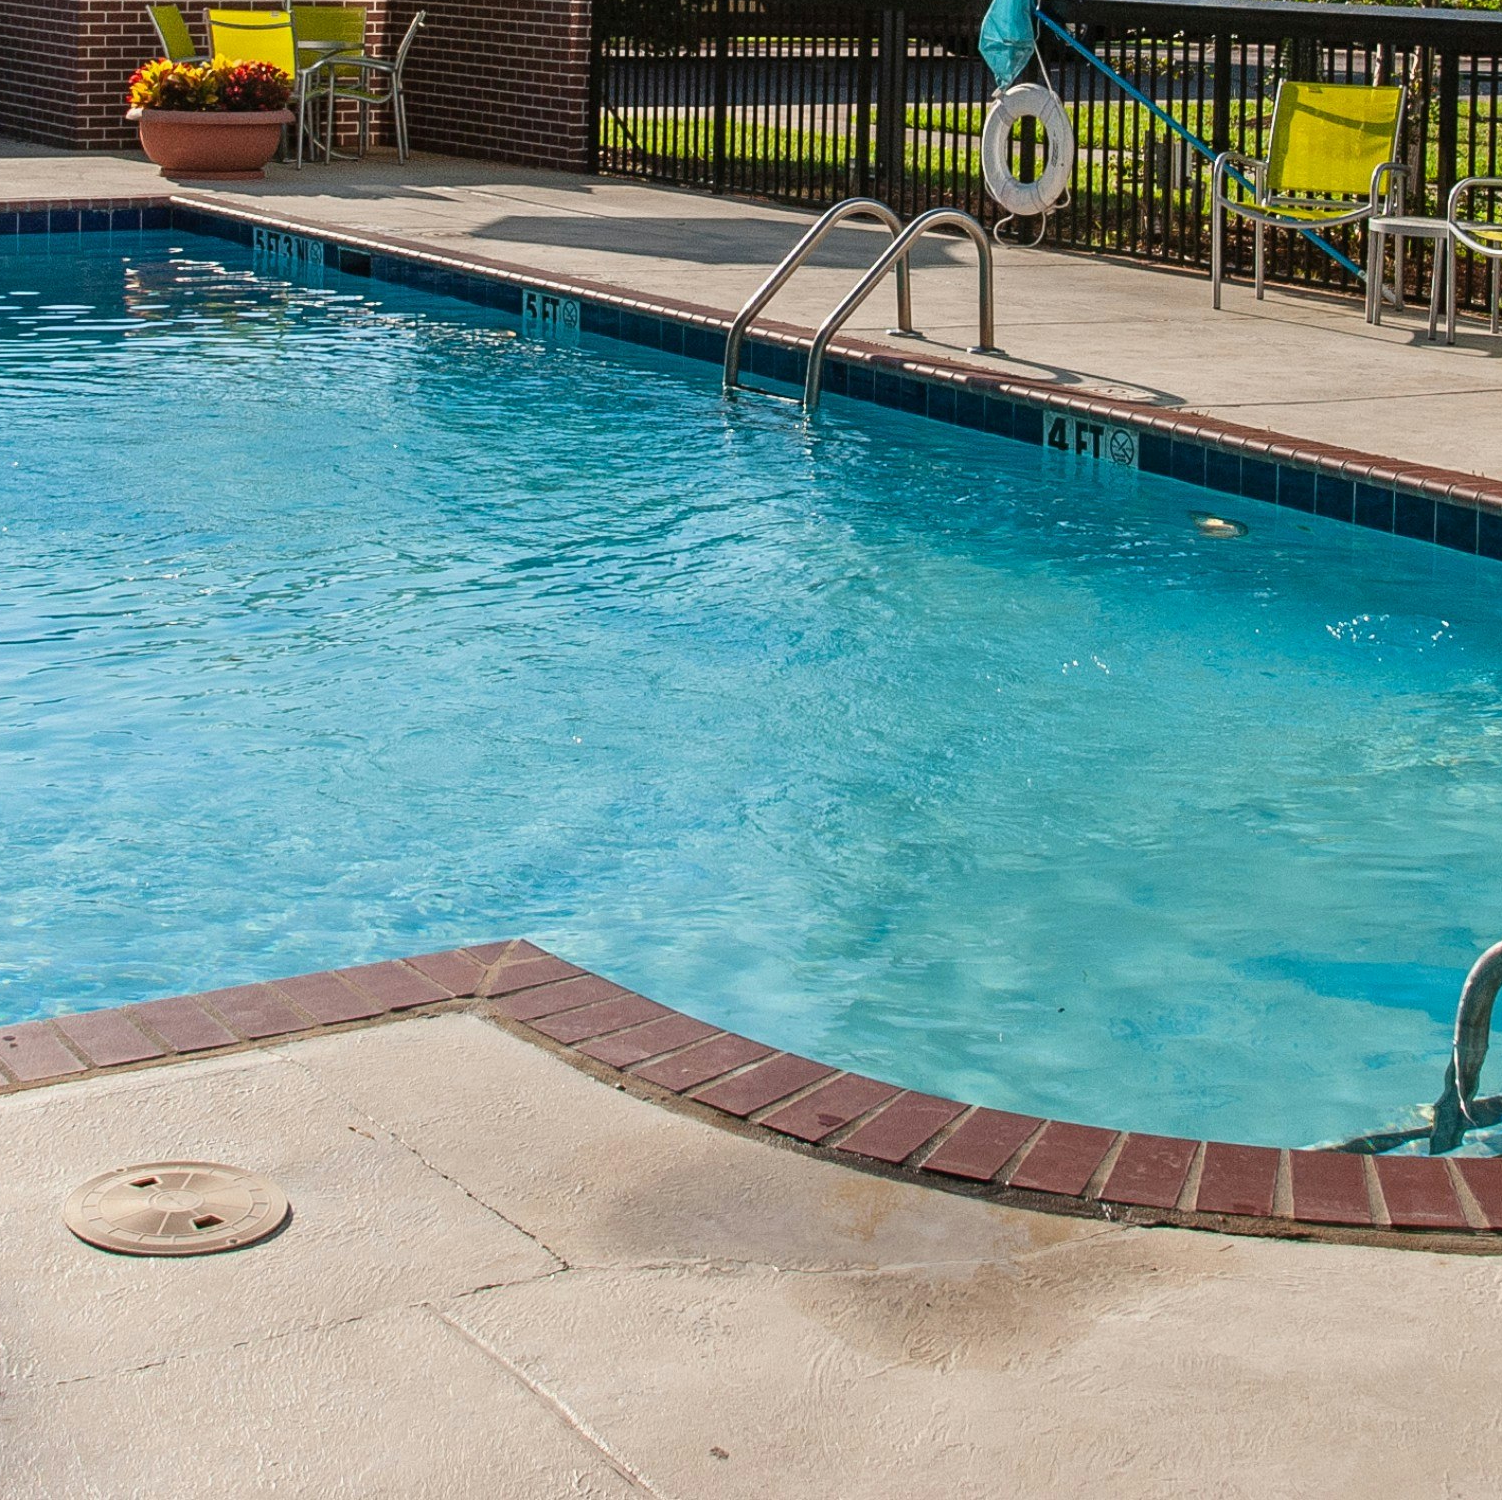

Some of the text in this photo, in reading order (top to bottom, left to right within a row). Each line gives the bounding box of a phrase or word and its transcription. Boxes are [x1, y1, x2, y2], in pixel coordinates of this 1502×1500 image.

[526, 293, 560, 325] 5 FT
[1048, 417, 1104, 458] 4 FT
